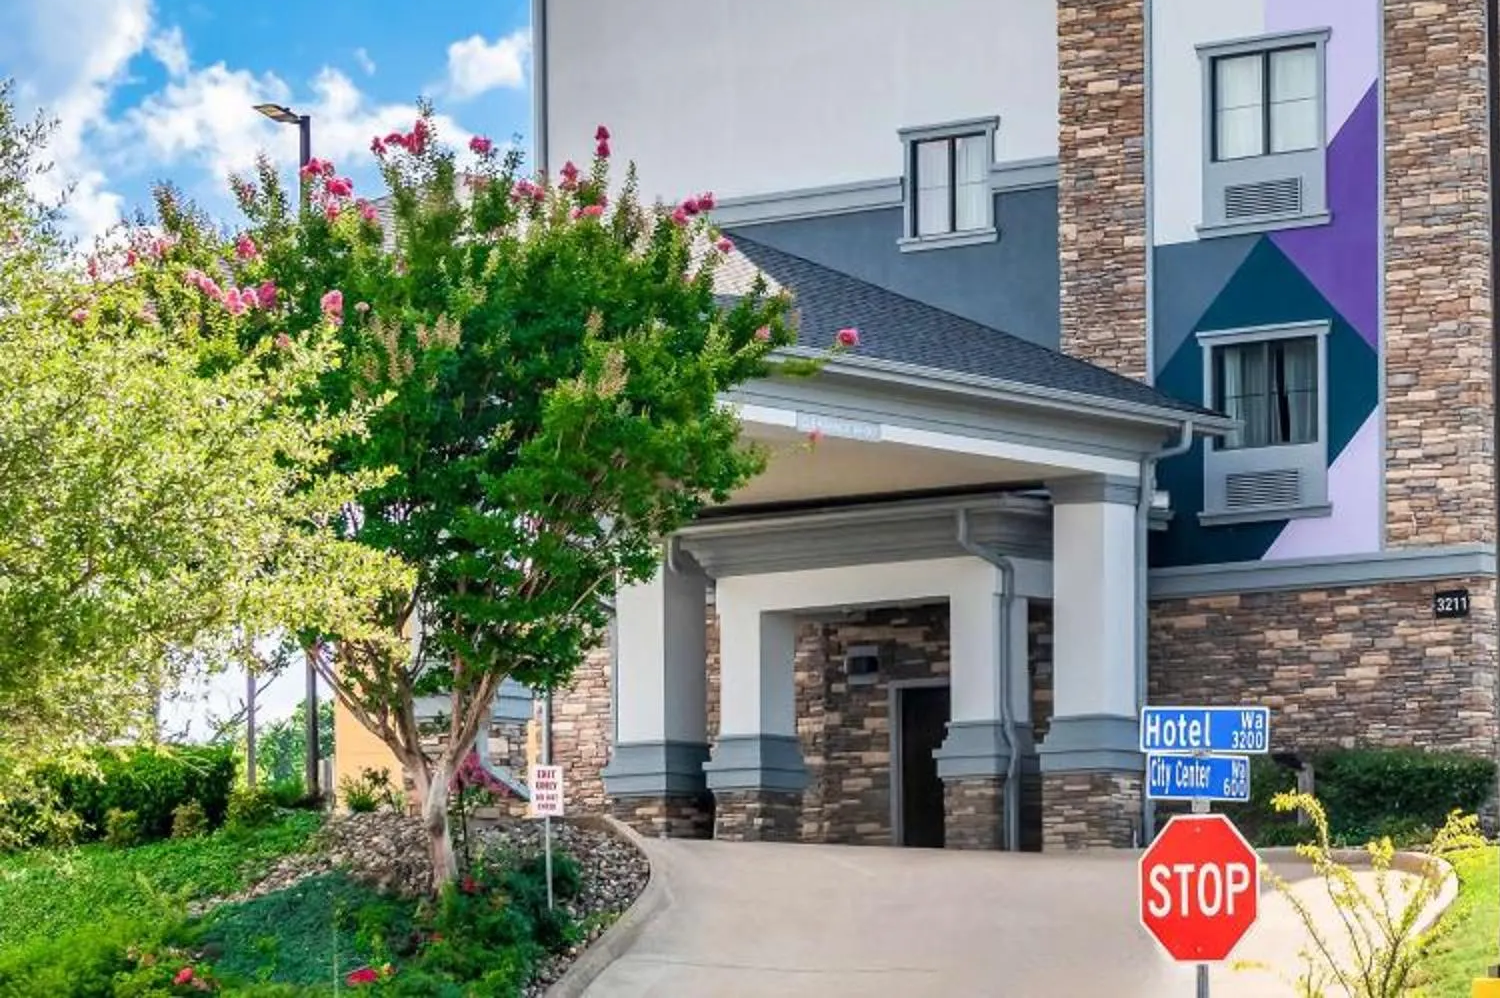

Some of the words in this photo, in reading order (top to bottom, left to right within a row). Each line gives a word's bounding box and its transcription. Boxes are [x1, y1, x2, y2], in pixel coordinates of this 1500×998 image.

[1437, 596, 1467, 612] 3211
[1145, 712, 1212, 747] Hotel
[1232, 730, 1264, 749] 3200
[1151, 758, 1171, 794] City
[1176, 760, 1211, 789] Center
[1223, 777, 1247, 797] 600
[1148, 862, 1250, 918] STOP
